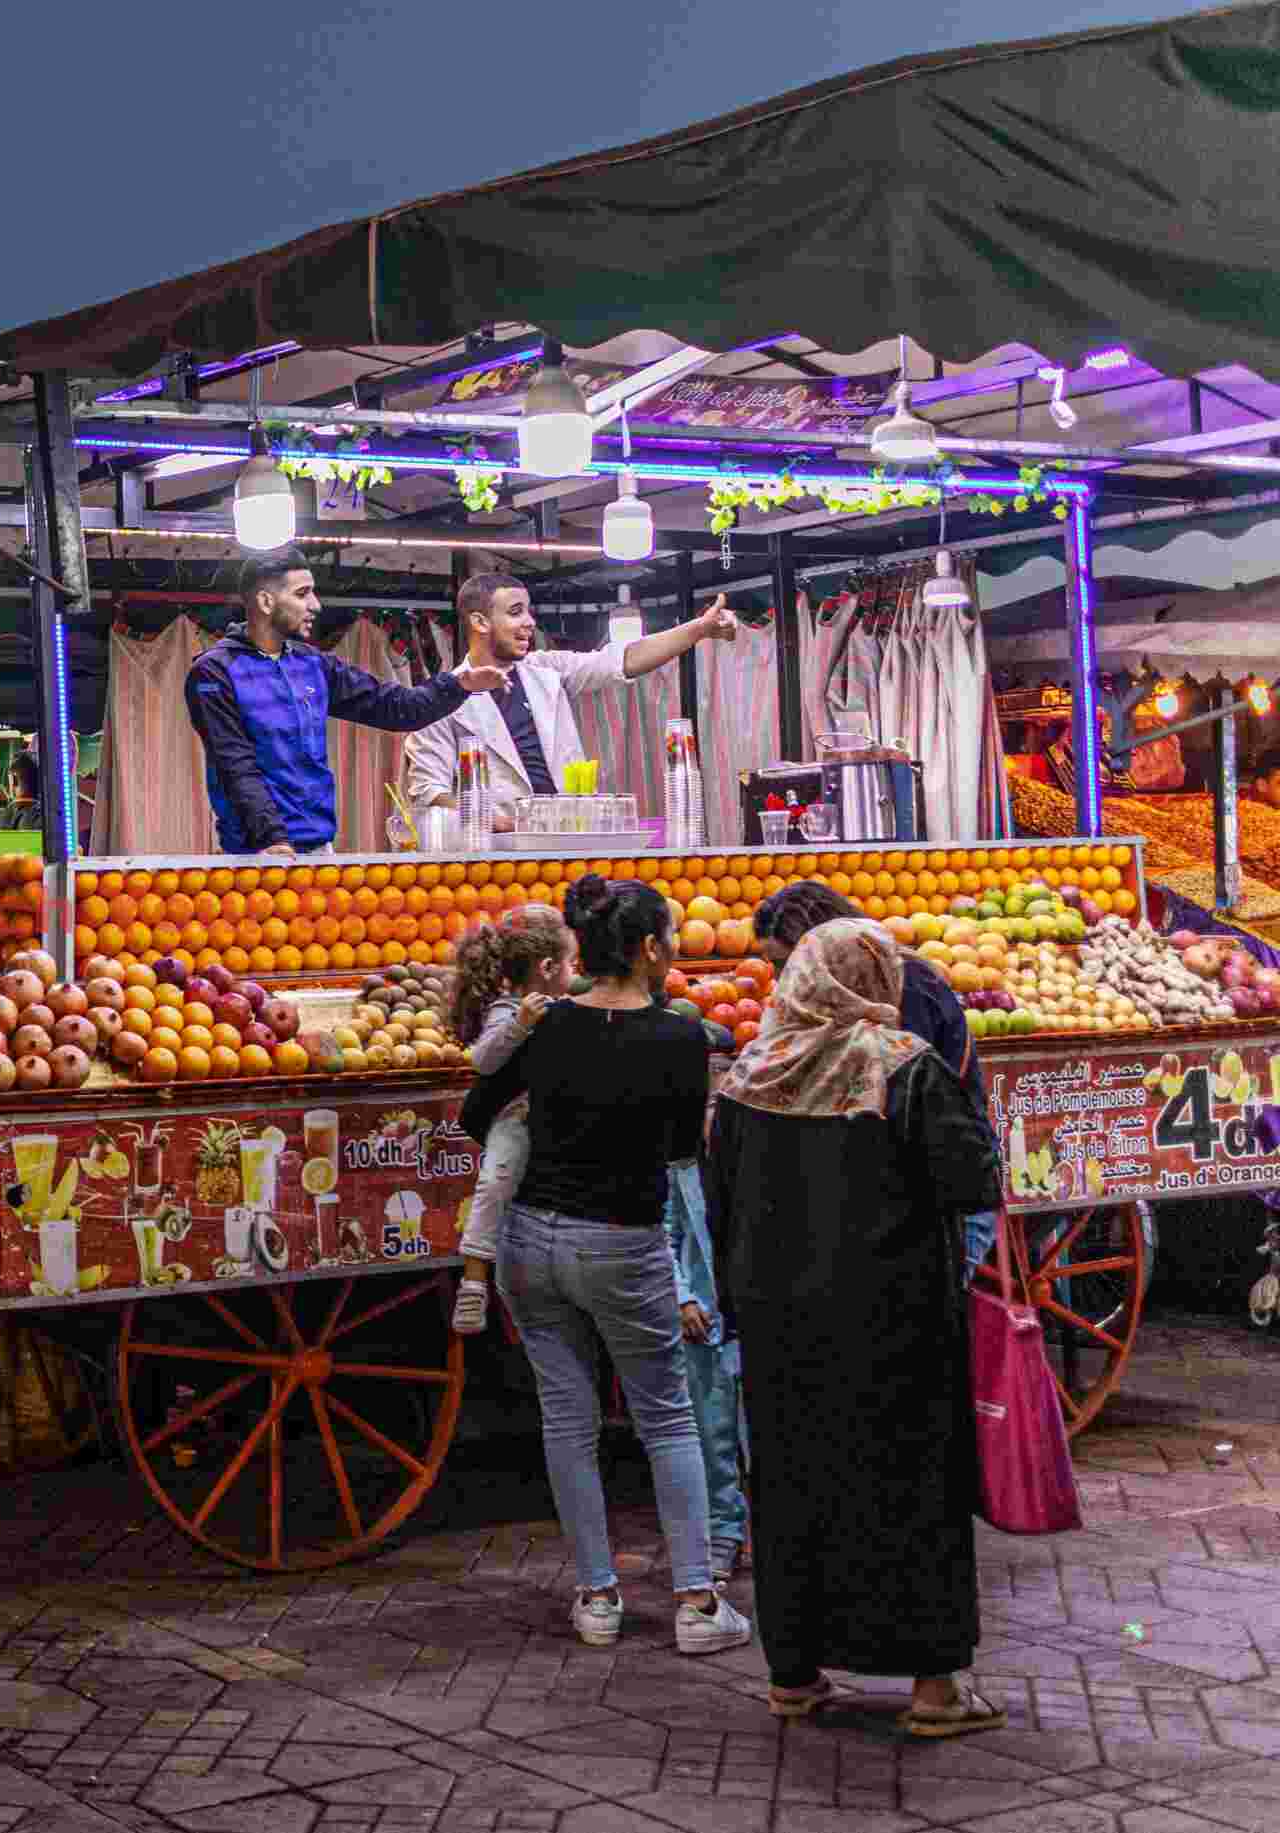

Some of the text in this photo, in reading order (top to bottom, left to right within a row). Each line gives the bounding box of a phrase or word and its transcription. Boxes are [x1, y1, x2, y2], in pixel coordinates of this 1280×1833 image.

[344, 1137, 473, 1176] 10 dh Jus
[1087, 1140, 1105, 1158] de
[1157, 1169, 1190, 1190] Jus
